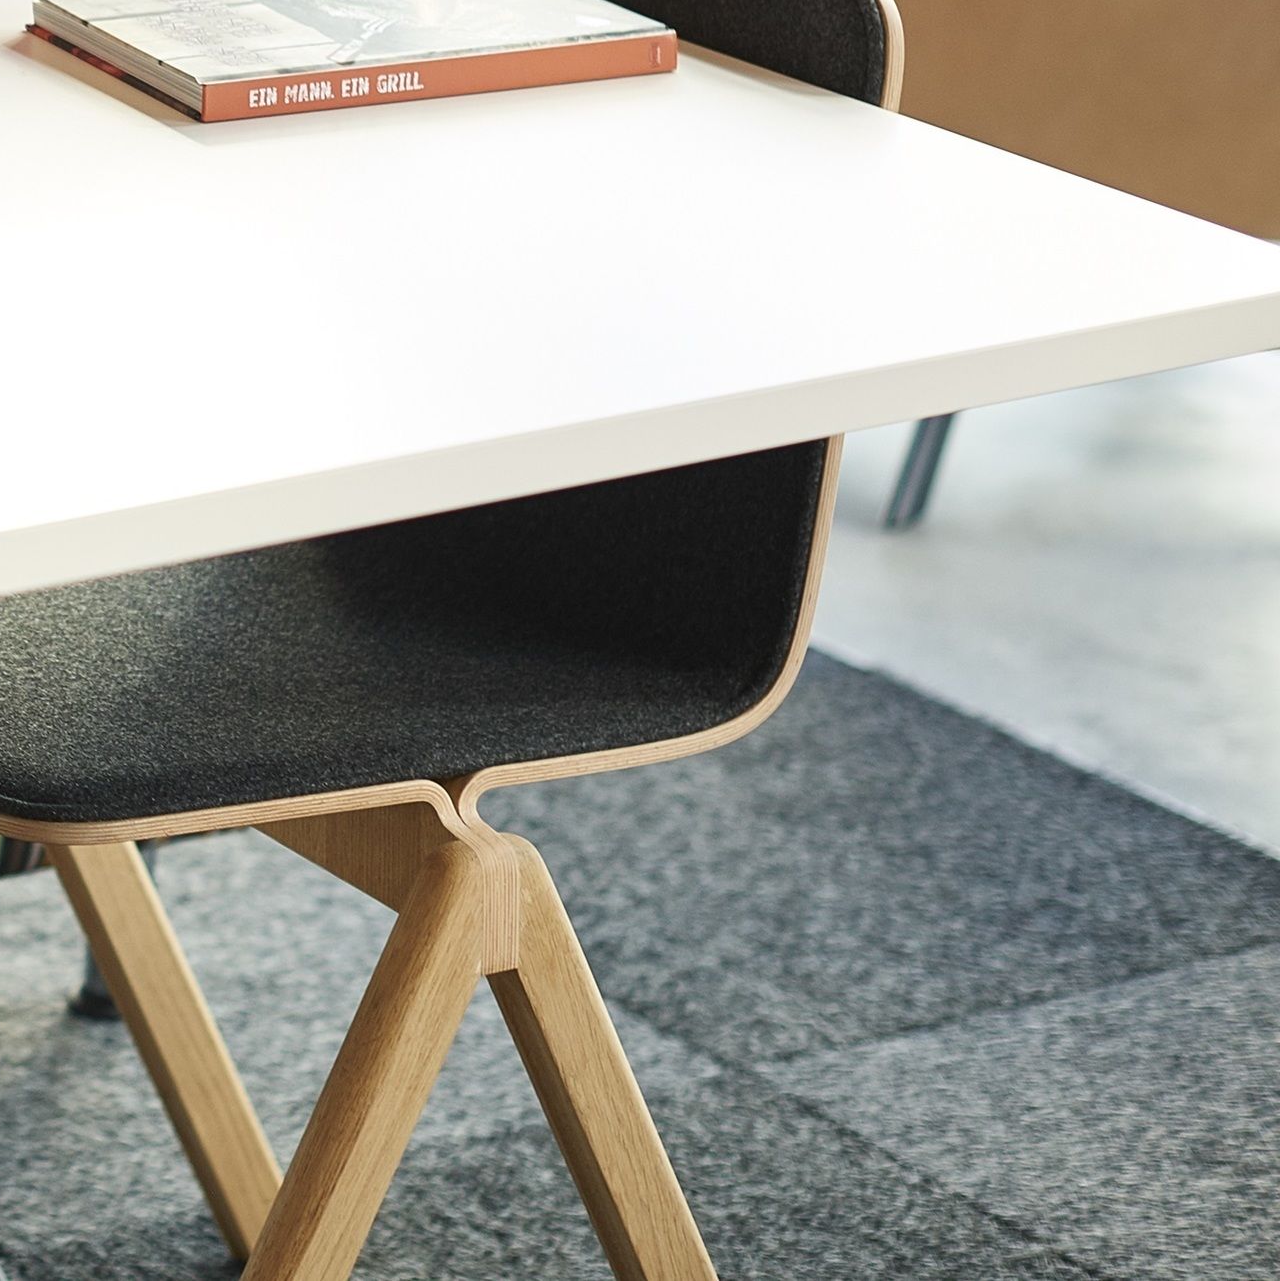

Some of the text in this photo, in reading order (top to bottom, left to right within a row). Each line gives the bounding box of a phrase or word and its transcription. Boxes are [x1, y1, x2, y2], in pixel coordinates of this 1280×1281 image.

[249, 86, 278, 108] EIN
[283, 80, 335, 104] MANN.
[341, 76, 370, 99] EIN
